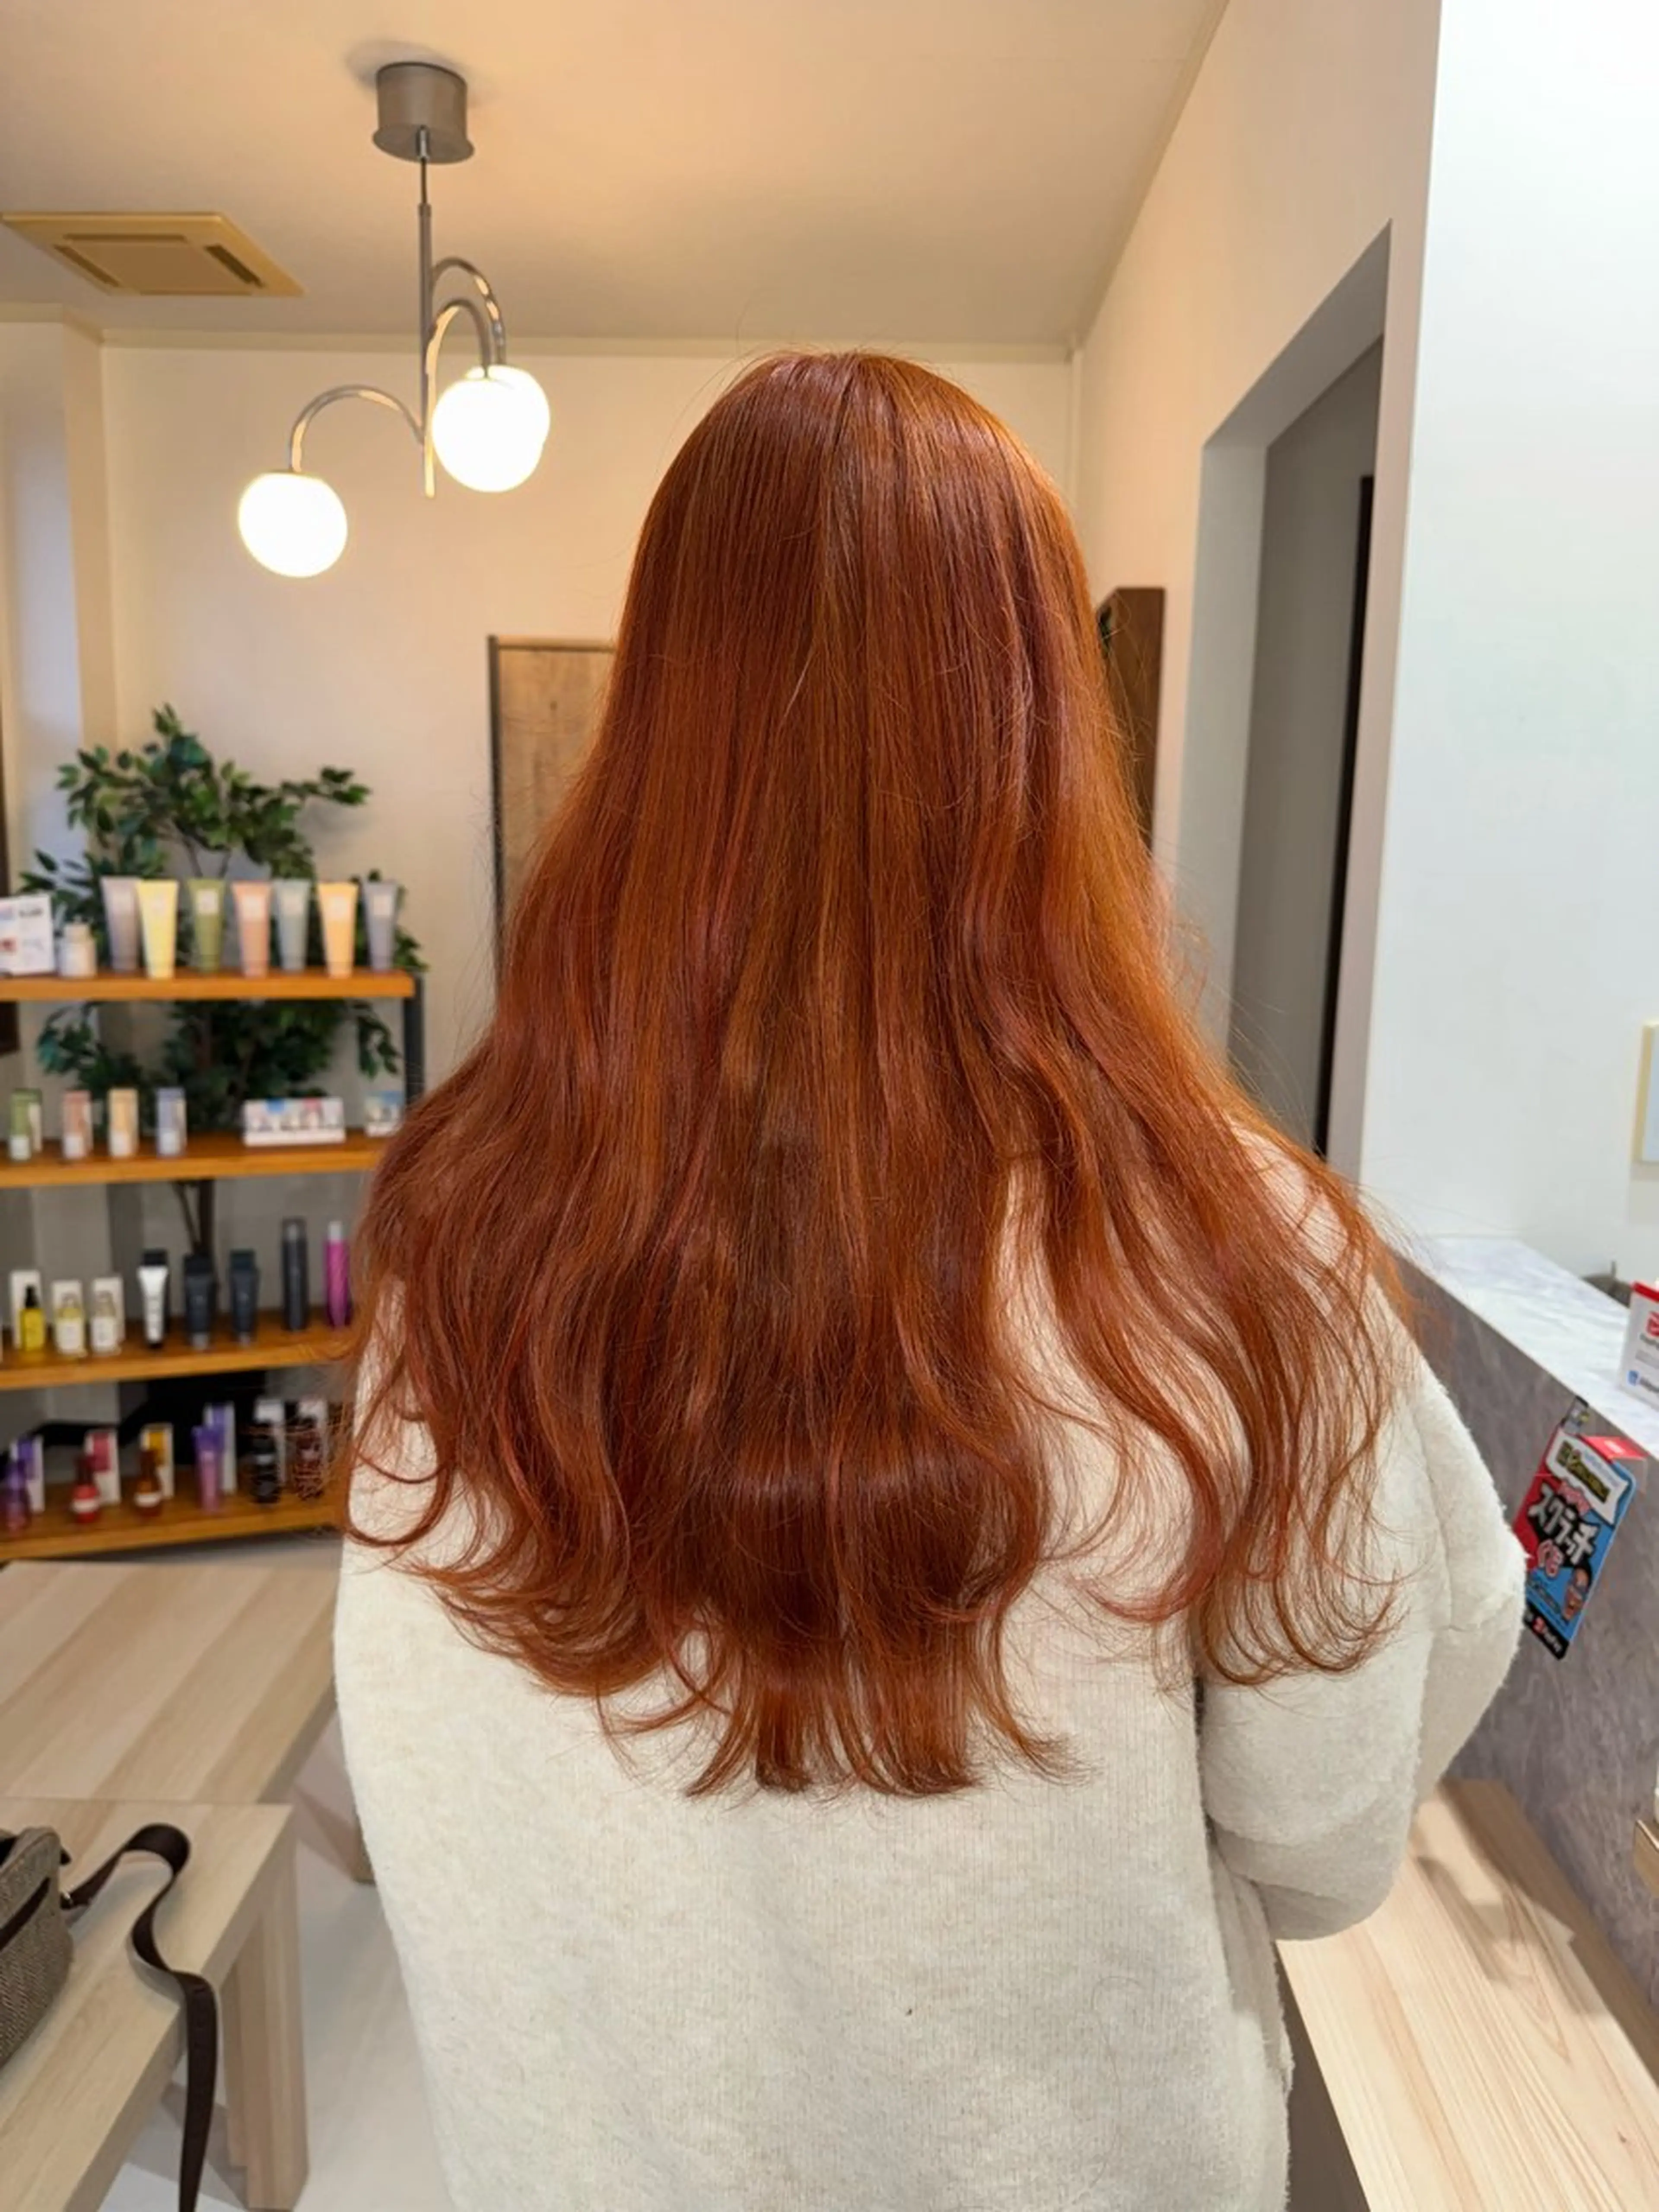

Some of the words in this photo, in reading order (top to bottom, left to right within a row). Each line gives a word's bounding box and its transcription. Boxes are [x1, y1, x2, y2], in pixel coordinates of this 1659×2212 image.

[1528, 1483, 1598, 1565] スクラッチ
